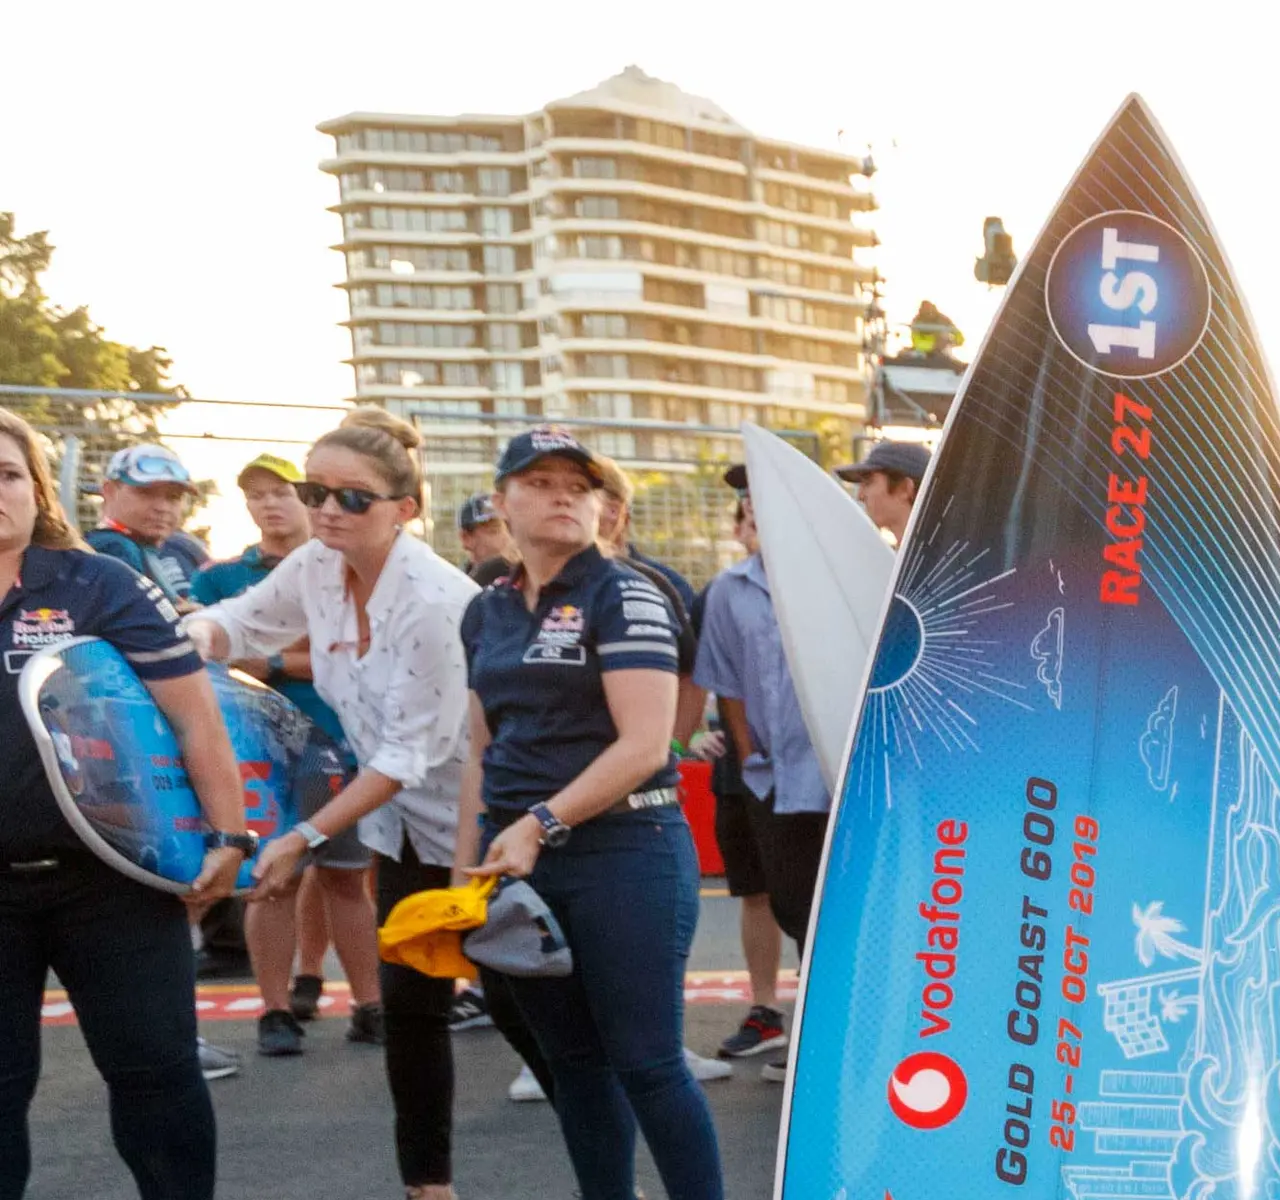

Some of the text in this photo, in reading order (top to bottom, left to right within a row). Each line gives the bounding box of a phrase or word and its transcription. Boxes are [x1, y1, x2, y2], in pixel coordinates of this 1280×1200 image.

[1087, 227, 1159, 360] 1ST
[1100, 392, 1152, 606] RACE 27
[915, 818, 969, 1039] vodafone
[1068, 815, 1101, 916] 2019
[995, 775, 1058, 1187] GOLD COAST 600
[1060, 926, 1090, 1004] OCT
